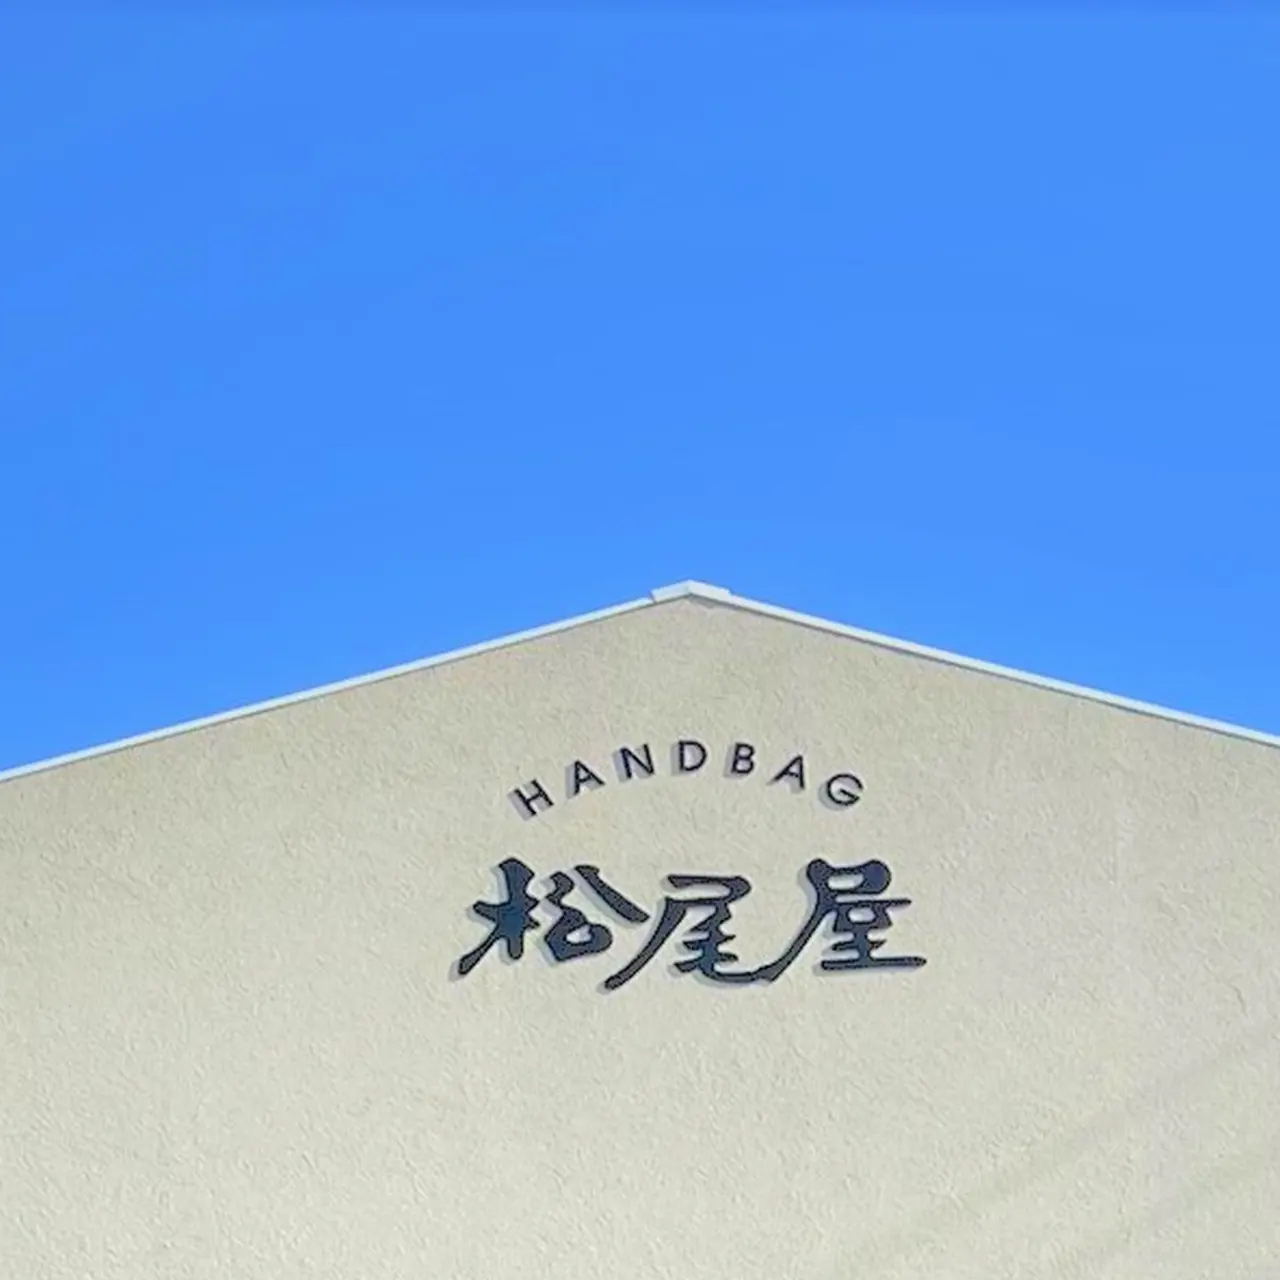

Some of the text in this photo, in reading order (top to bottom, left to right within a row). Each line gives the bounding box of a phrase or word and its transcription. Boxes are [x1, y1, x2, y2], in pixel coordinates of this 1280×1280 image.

[512, 739, 863, 817] HANDBAG
[456, 856, 927, 991] 松尾屋
